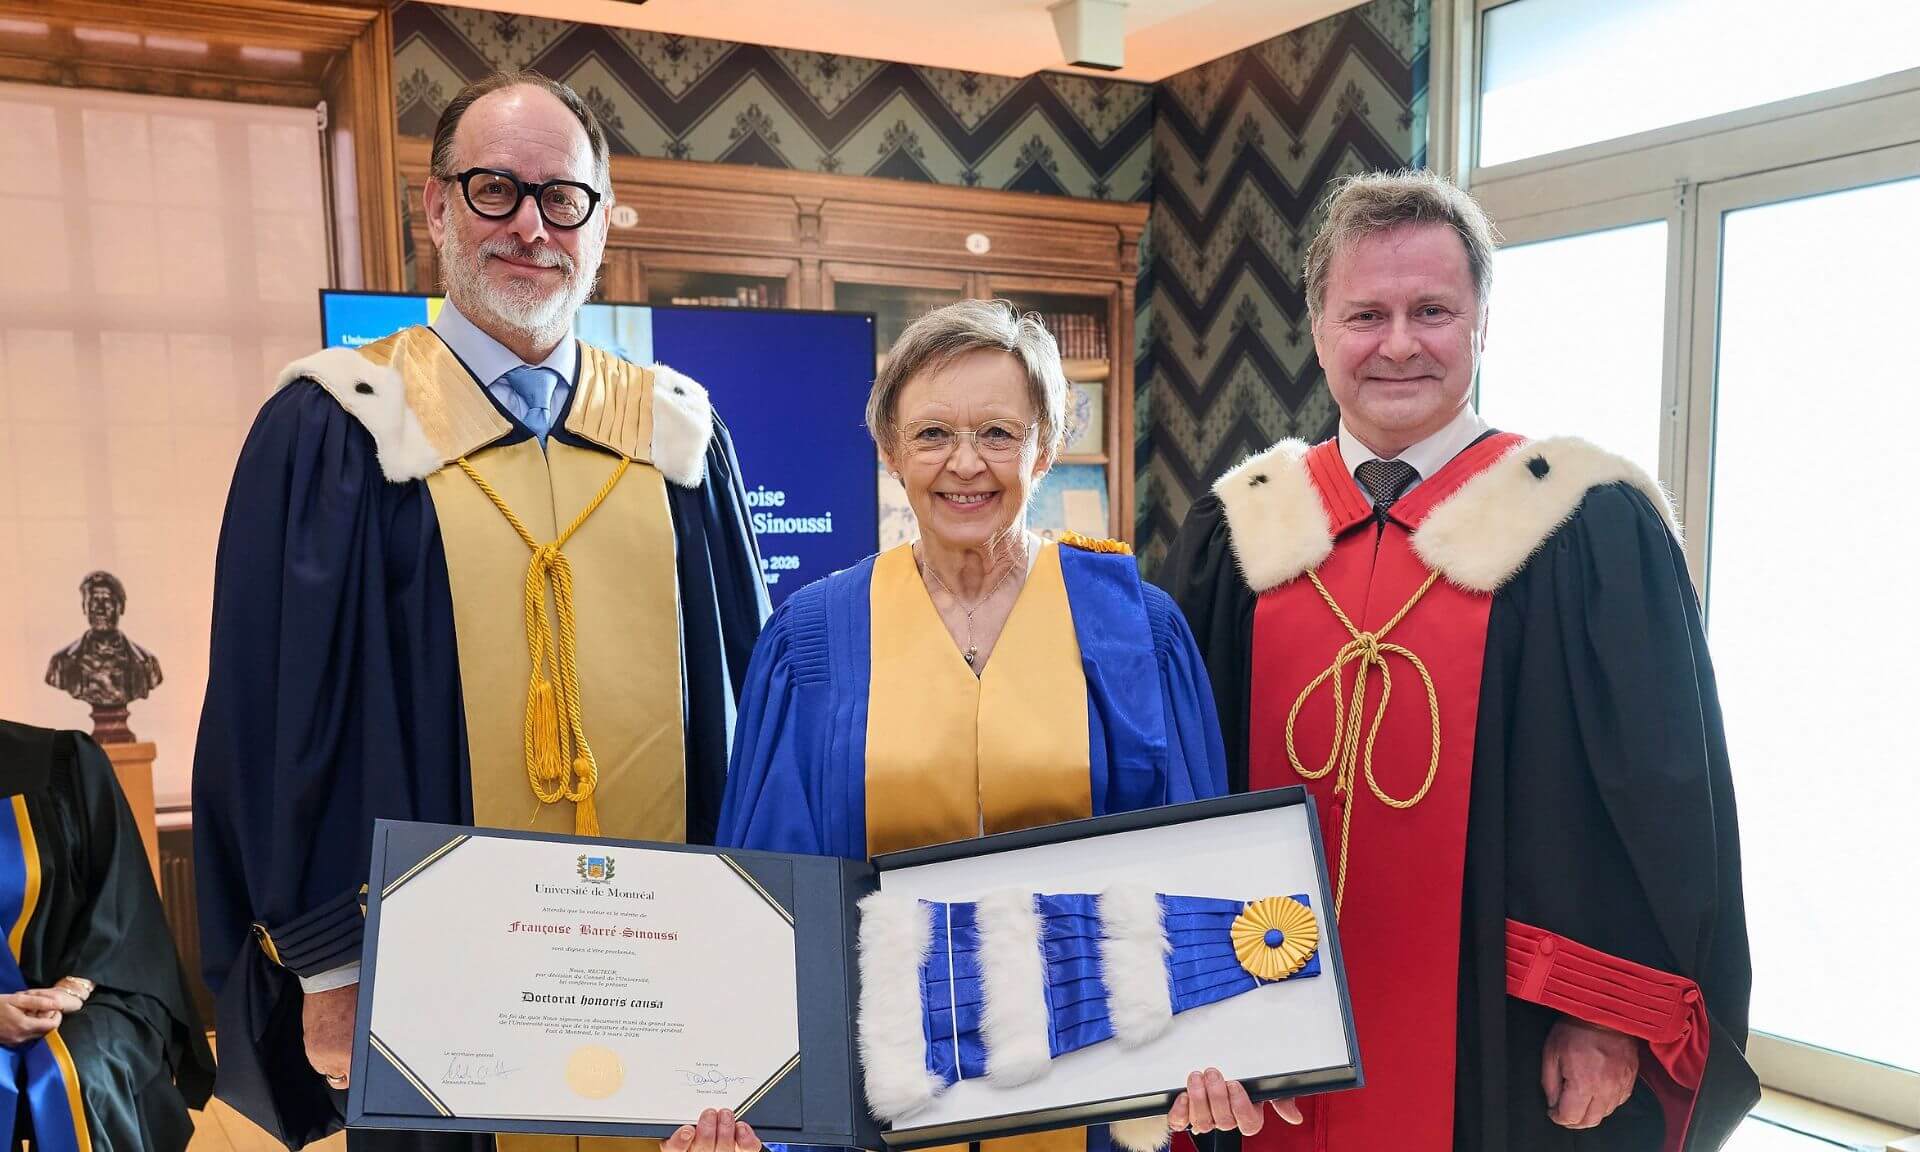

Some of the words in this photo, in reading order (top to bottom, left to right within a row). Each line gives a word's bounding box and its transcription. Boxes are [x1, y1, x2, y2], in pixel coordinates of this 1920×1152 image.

[753, 511, 832, 533] Sinoussi
[770, 556, 800, 570] 2026
[535, 884, 589, 896] Université
[591, 887, 604, 896] de
[608, 888, 655, 900] Montréal
[507, 921, 572, 935] Françoise
[580, 924, 679, 941] Barré-Sinoussi
[522, 991, 576, 1004] Doctorat
[580, 995, 627, 1007] honoris
[630, 999, 664, 1009] causa
